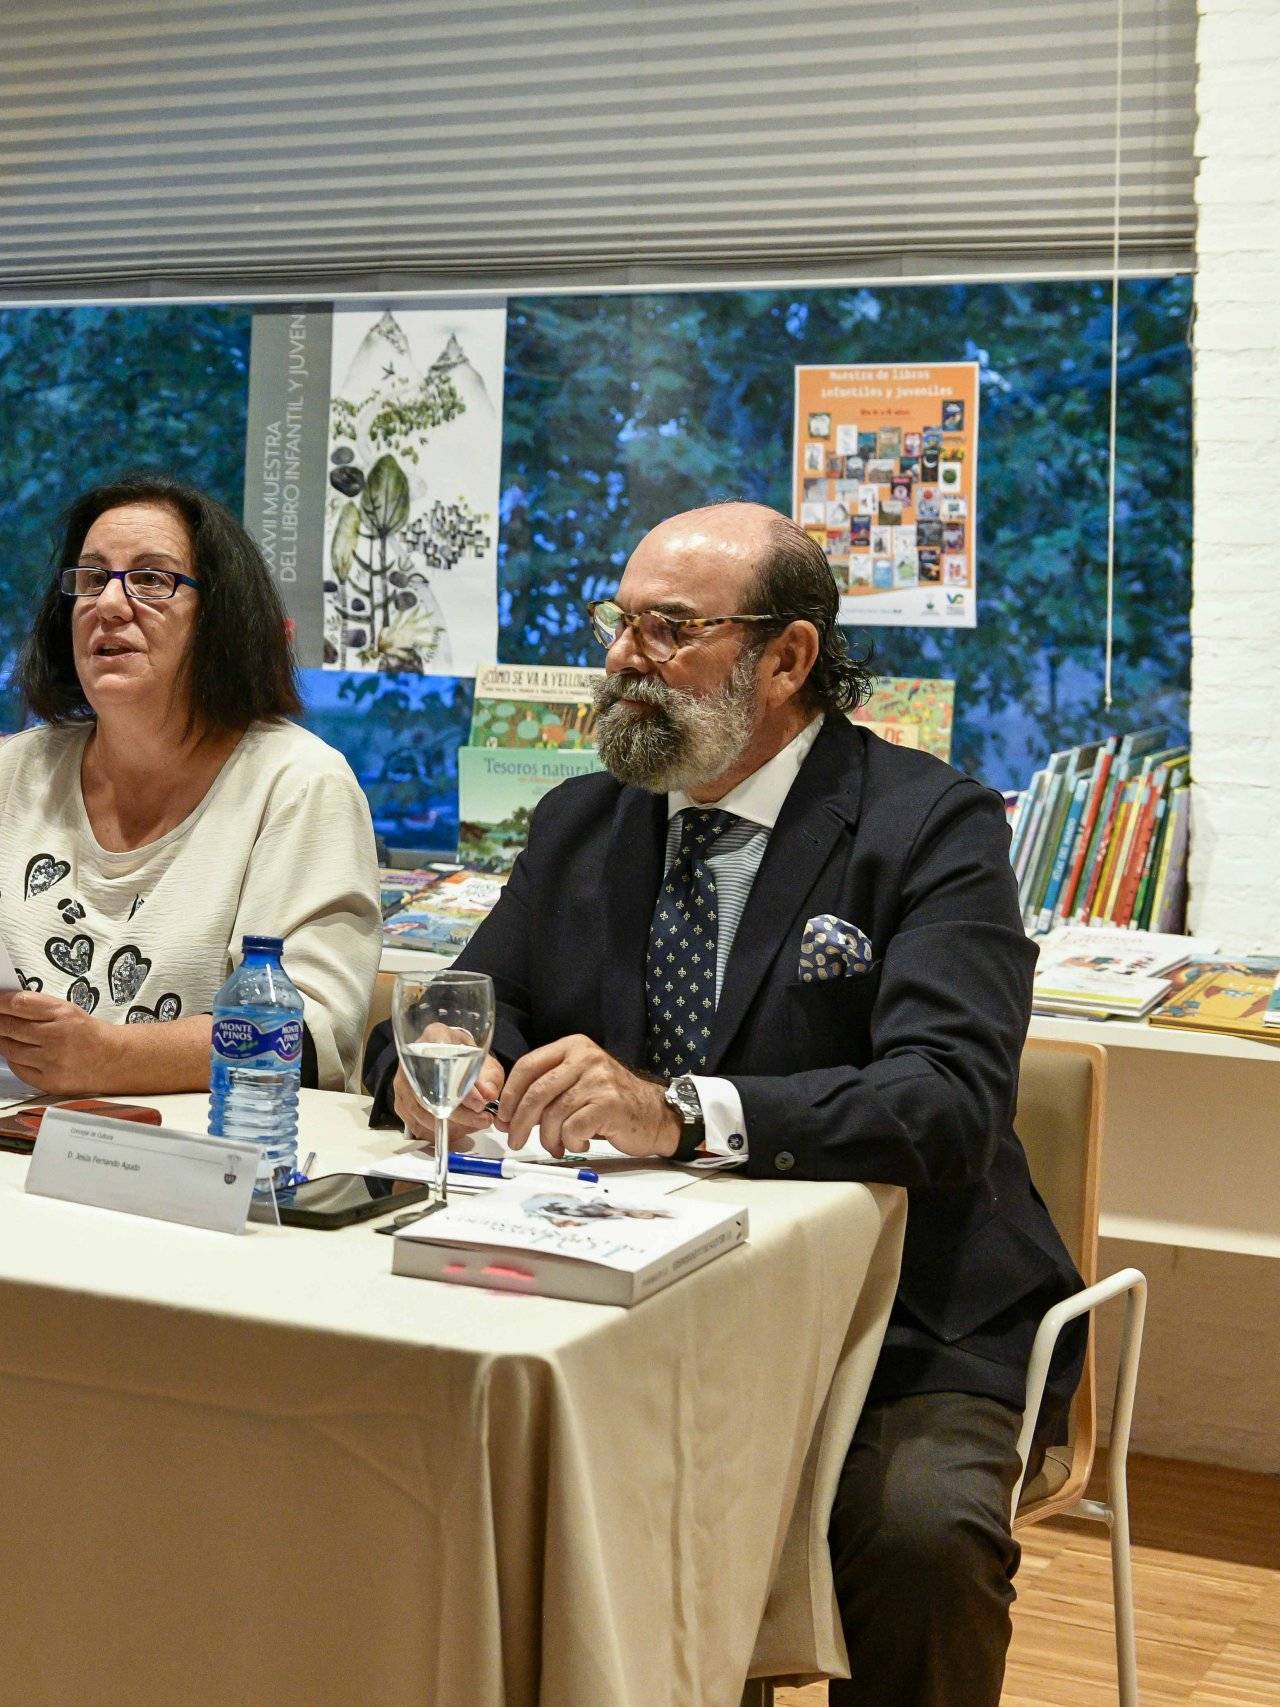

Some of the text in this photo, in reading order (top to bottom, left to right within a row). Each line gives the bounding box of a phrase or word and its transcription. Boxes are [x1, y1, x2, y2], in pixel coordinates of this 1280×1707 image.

[288, 379, 304, 392] Y
[284, 399, 304, 481] INFANTIL
[262, 421, 282, 515] MUESTRA
[282, 484, 300, 540] LIBRO
[280, 543, 297, 581] DEL
[513, 670, 525, 685] SE
[527, 671, 540, 686] VA
[542, 672, 548, 686] A
[484, 757, 538, 775] Tesoros
[220, 1022, 252, 1033] MONTE
[223, 1031, 253, 1041] PINOS
